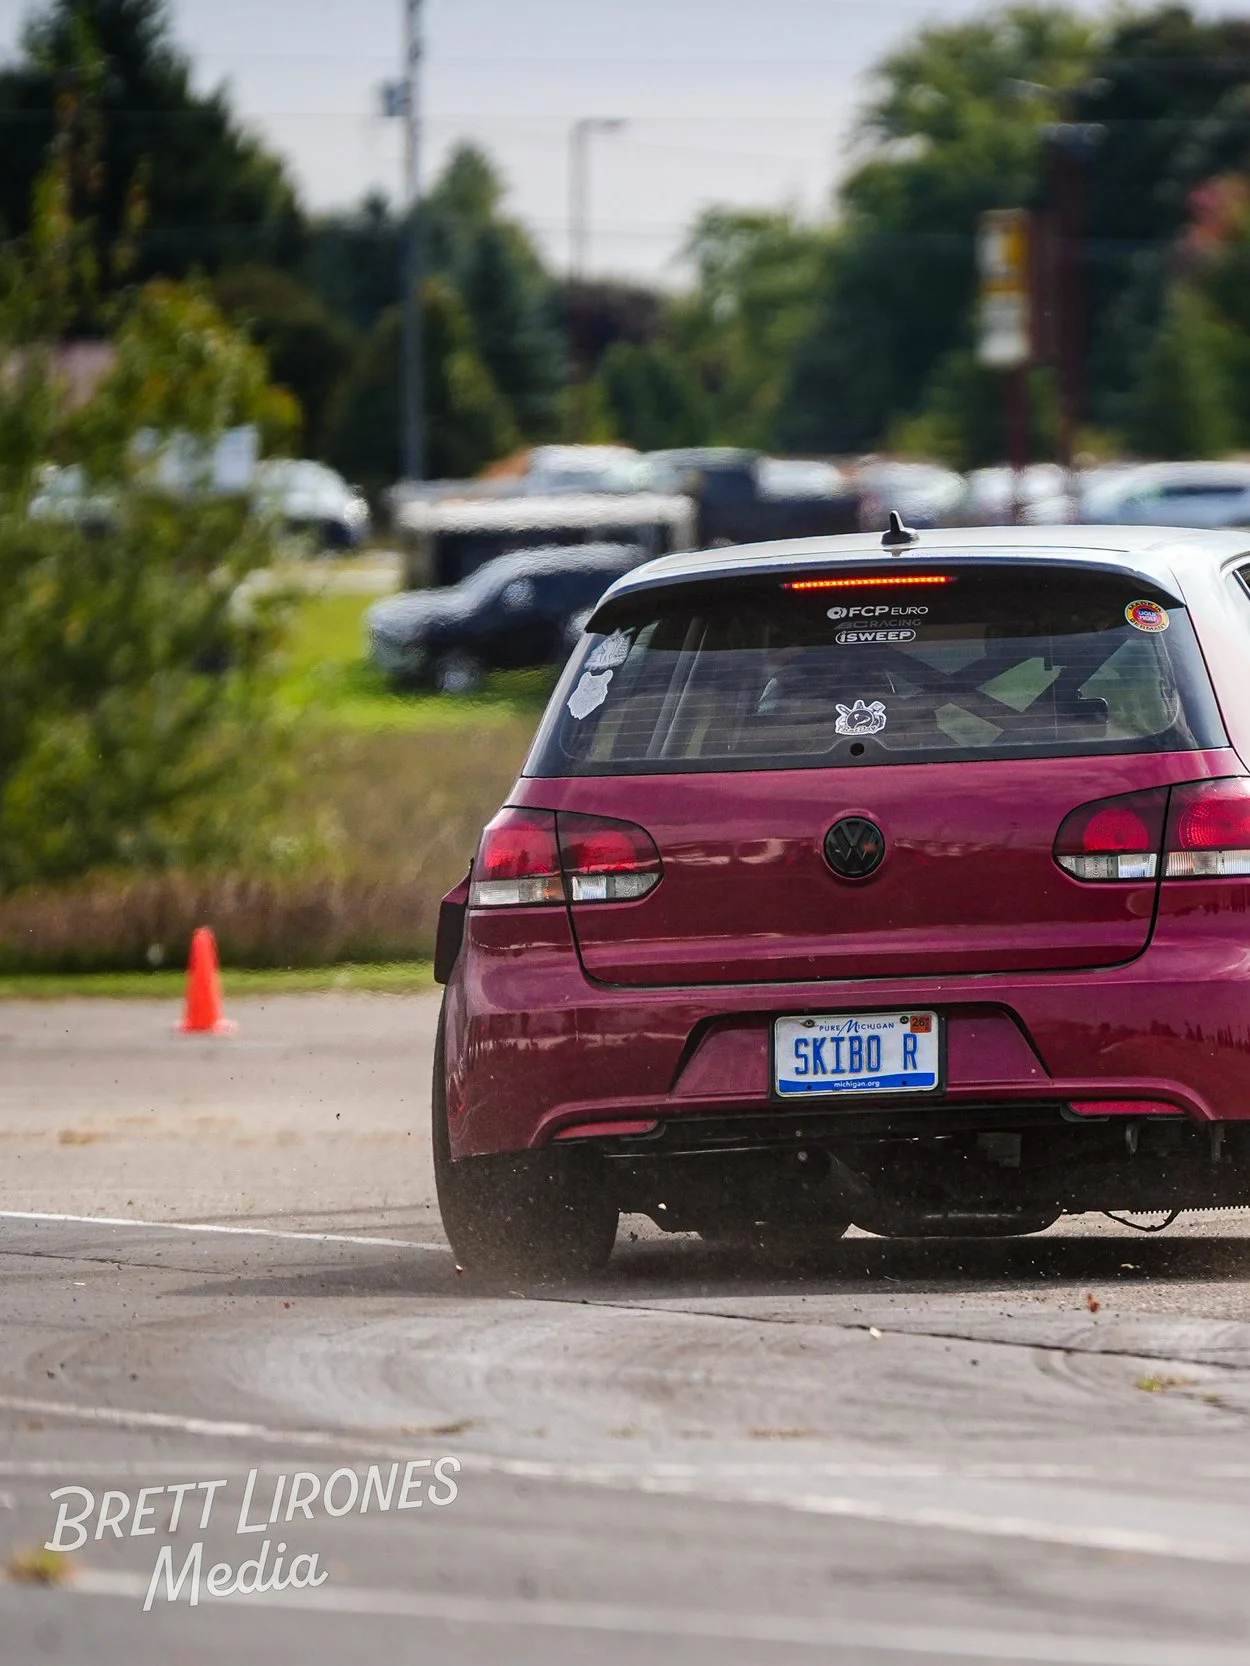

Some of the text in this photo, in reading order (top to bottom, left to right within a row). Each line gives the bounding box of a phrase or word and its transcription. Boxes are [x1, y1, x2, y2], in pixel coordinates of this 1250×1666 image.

[848, 605, 929, 617] FCP EURO
[1128, 601, 1152, 610] MADE
[869, 618, 922, 629] RACING
[1130, 618, 1166, 630] GERMANY
[819, 1019, 895, 1036] PURE MICHIGAN
[912, 1017, 925, 1027] 26
[794, 1033, 918, 1076] SKIBO R
[833, 1080, 880, 1089] michigan.org
